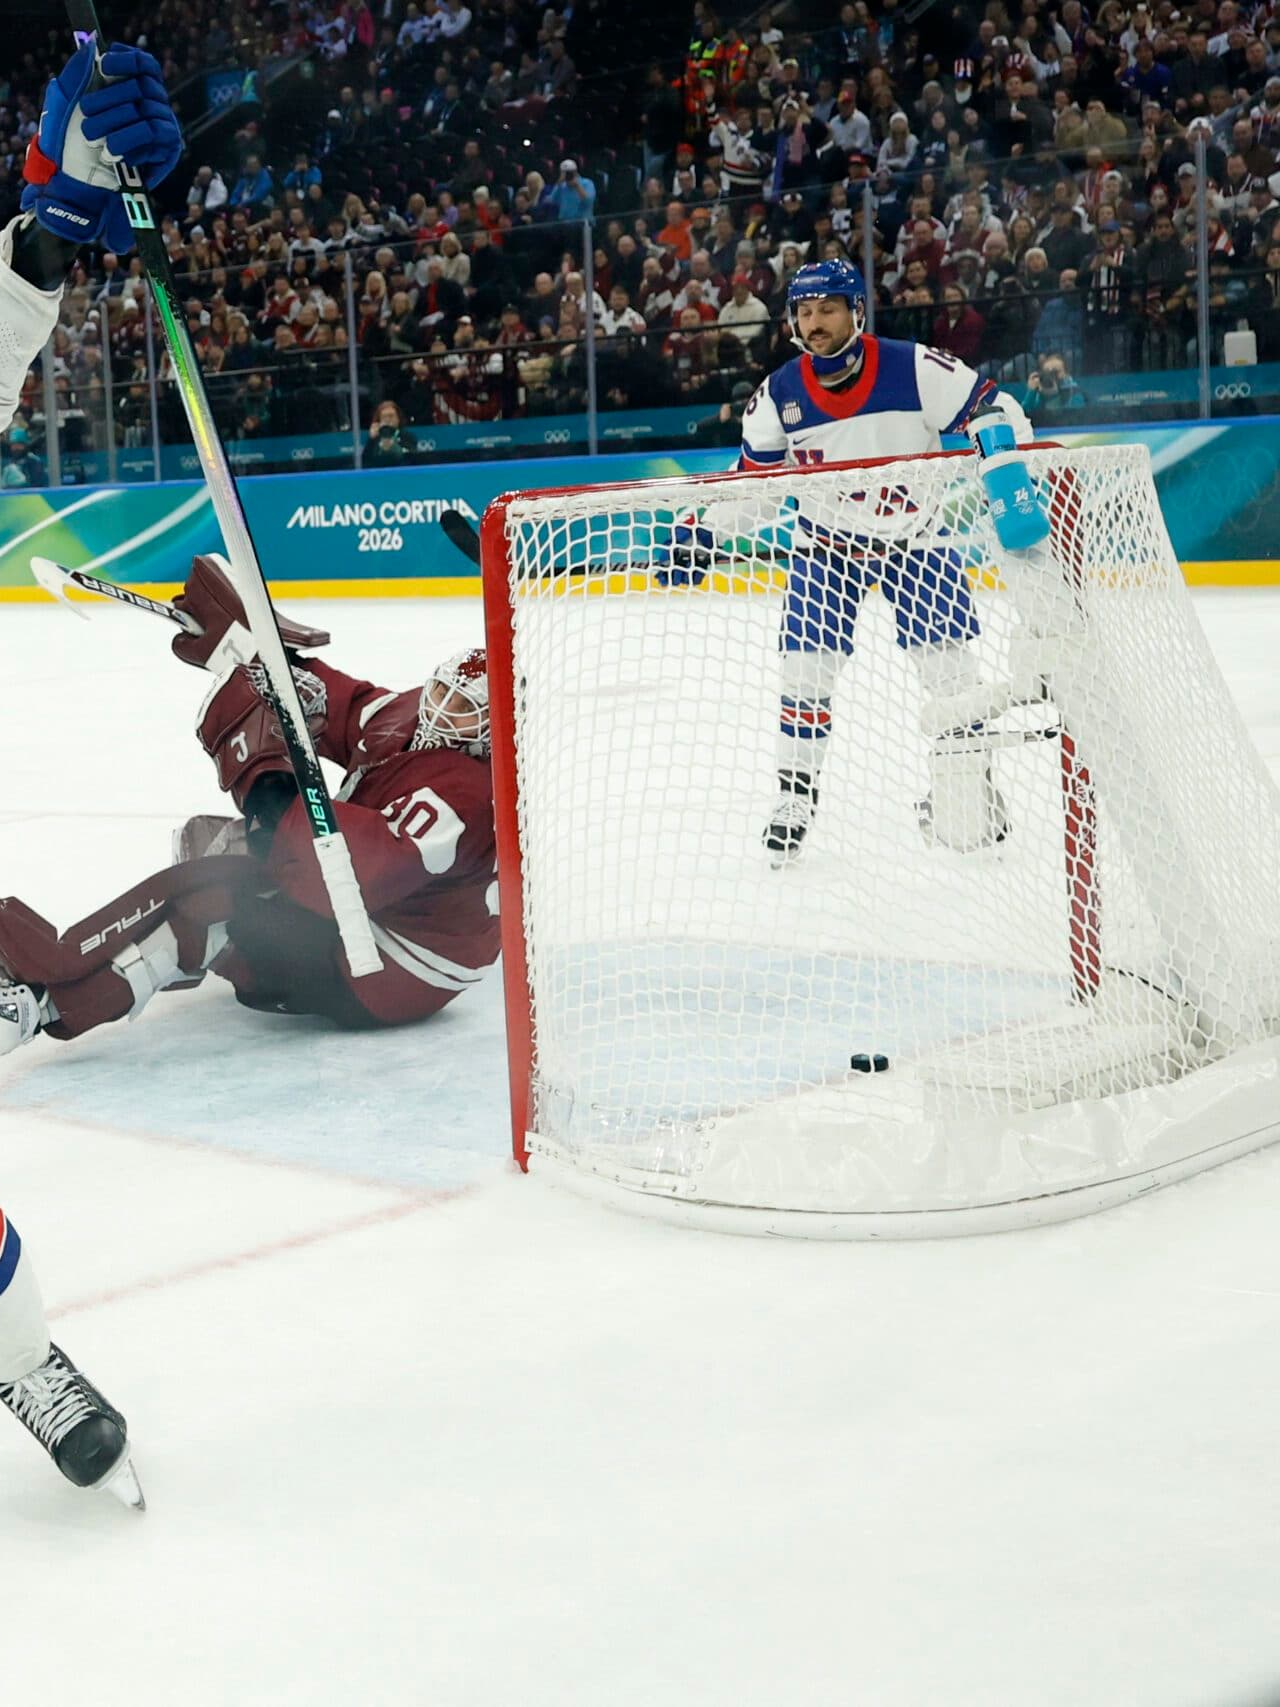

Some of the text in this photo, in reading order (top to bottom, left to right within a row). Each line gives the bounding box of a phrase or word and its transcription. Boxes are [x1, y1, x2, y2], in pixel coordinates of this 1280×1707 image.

[286, 503, 376, 528] MILANO
[358, 528, 403, 552] 2026
[80, 898, 166, 956] TRUE
